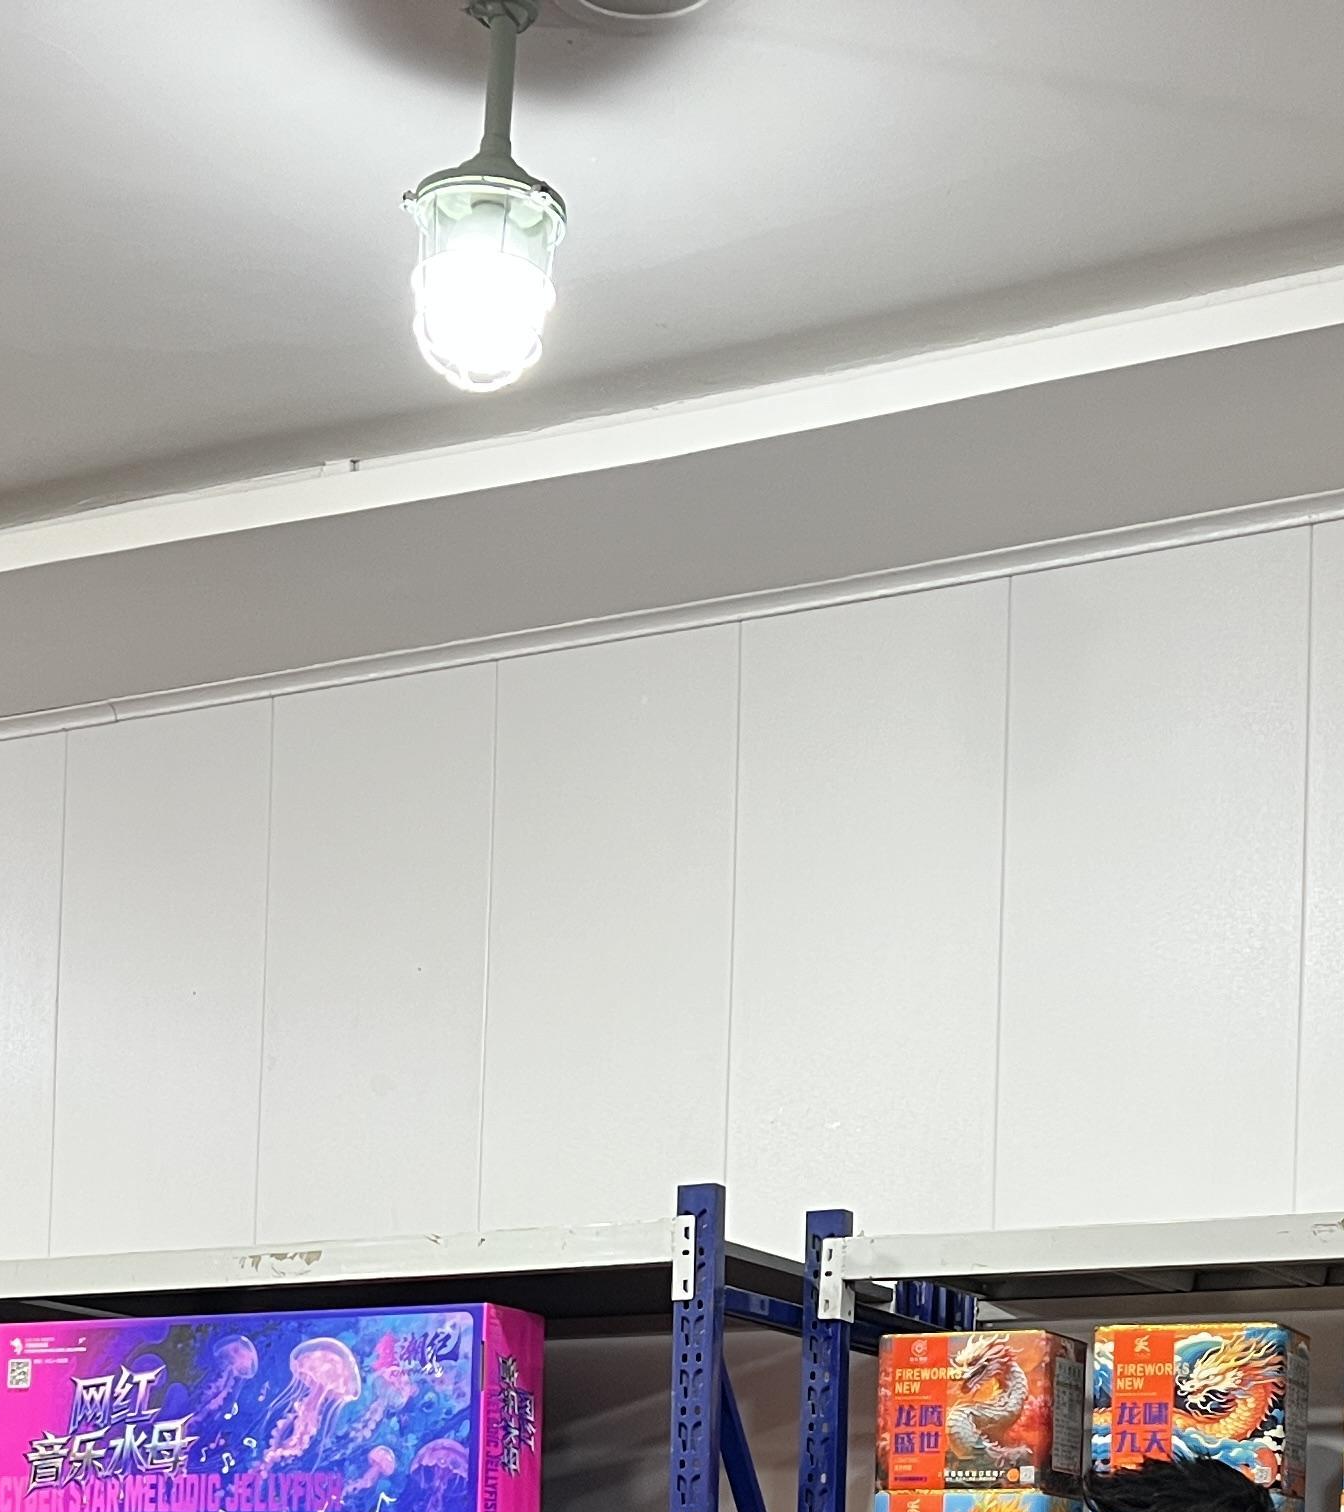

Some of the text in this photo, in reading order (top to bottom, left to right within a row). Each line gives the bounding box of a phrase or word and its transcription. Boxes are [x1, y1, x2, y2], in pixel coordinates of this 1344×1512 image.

[1117, 1363, 1190, 1376] FIREWORKS
[895, 1382, 921, 1394] NEW
[1116, 1378, 1144, 1390] NEW
[70, 1365, 166, 1433] 网红
[25, 1413, 199, 1497] 音乐水母
